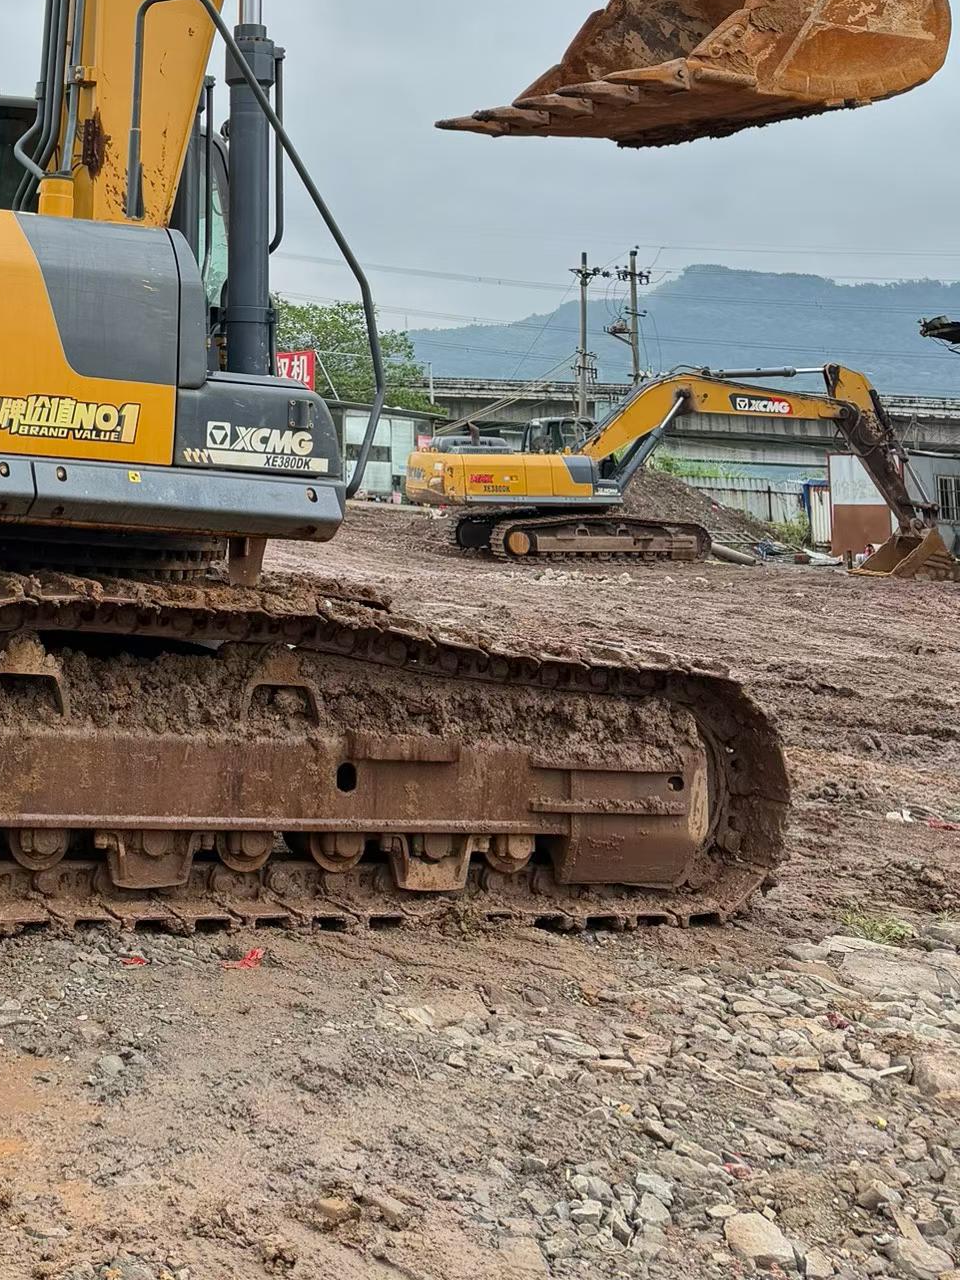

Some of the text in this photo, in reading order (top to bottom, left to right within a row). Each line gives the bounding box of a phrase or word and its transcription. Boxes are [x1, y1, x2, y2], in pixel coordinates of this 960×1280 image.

[749, 399, 790, 413] XCMG
[19, 424, 120, 441] BRAND VALUE
[230, 426, 314, 456] XCMG
[263, 455, 312, 470] XE380DK
